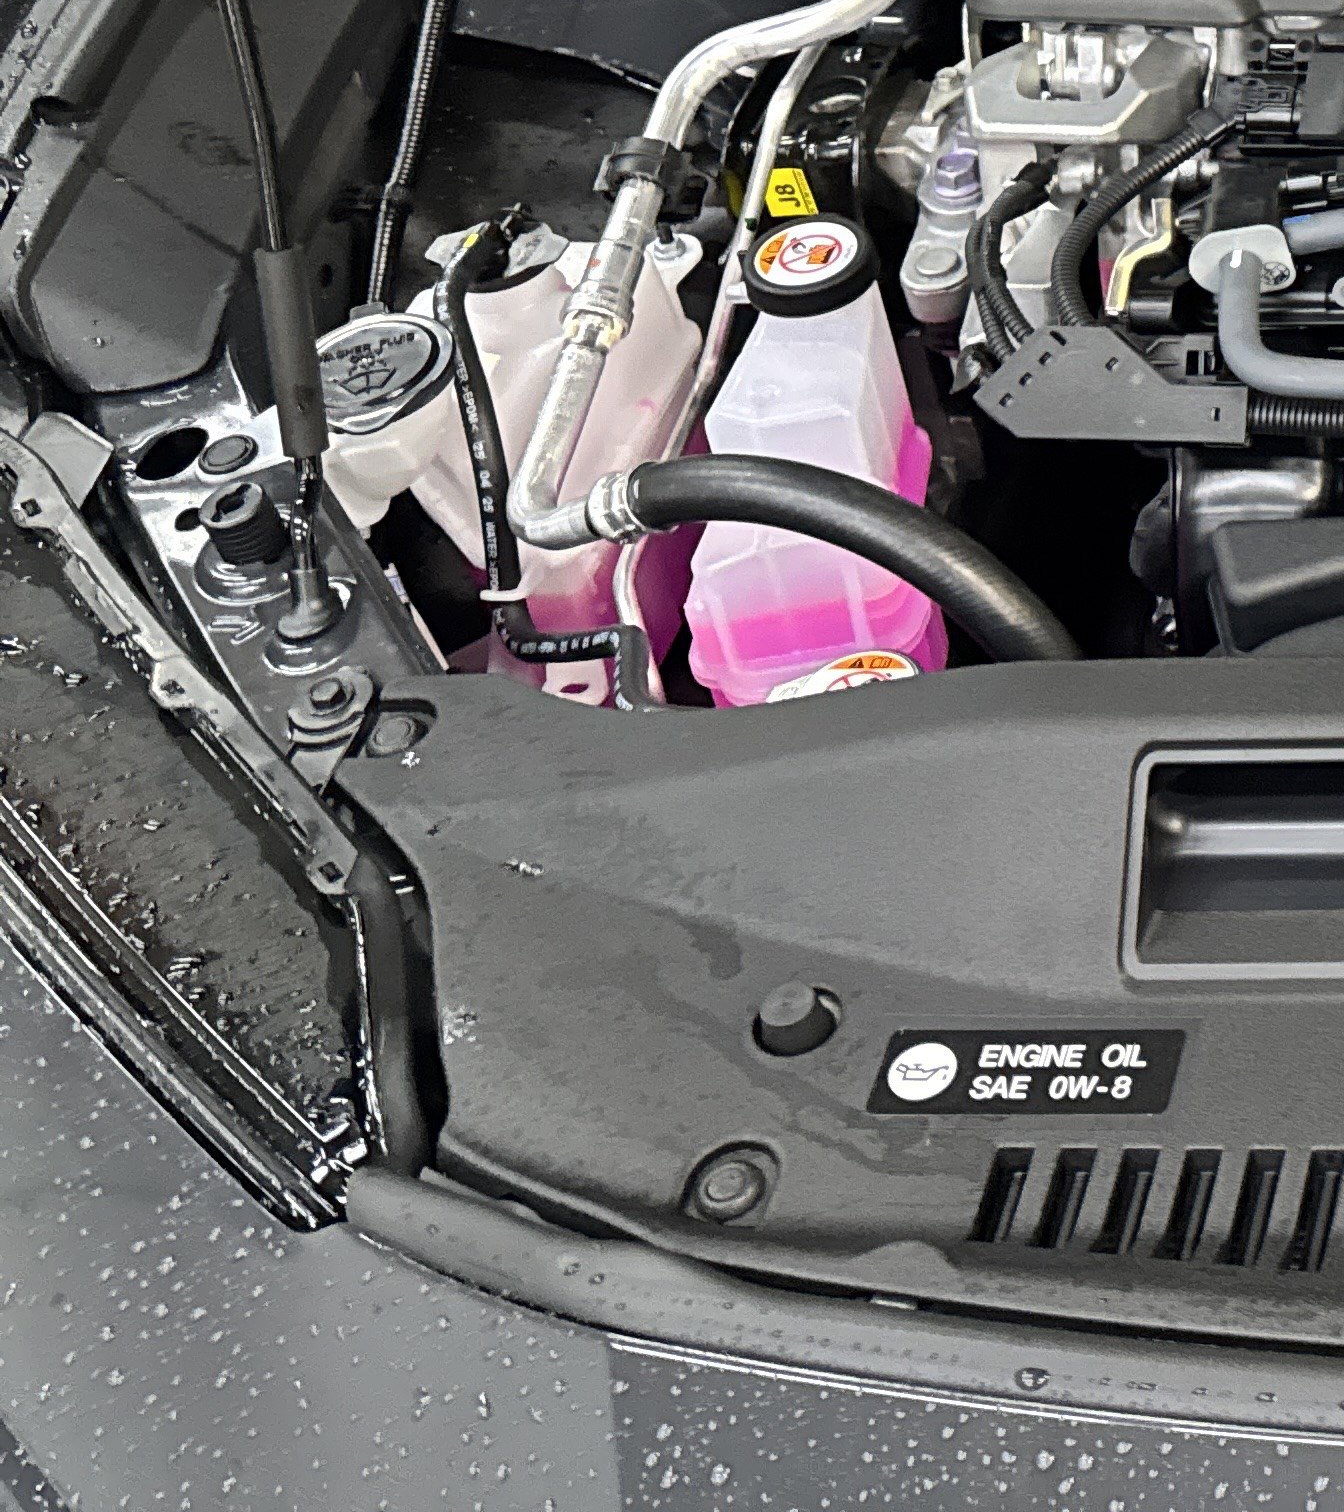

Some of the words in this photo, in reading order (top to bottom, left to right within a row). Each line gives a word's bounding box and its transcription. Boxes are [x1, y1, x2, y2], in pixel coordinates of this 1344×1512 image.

[774, 183, 801, 208] J8
[485, 521, 498, 559] WATER
[977, 1043, 1086, 1068] ENGINE
[1101, 1043, 1147, 1068] OIL
[968, 1075, 1032, 1100] SAE
[1048, 1075, 1133, 1100] 0W-8
